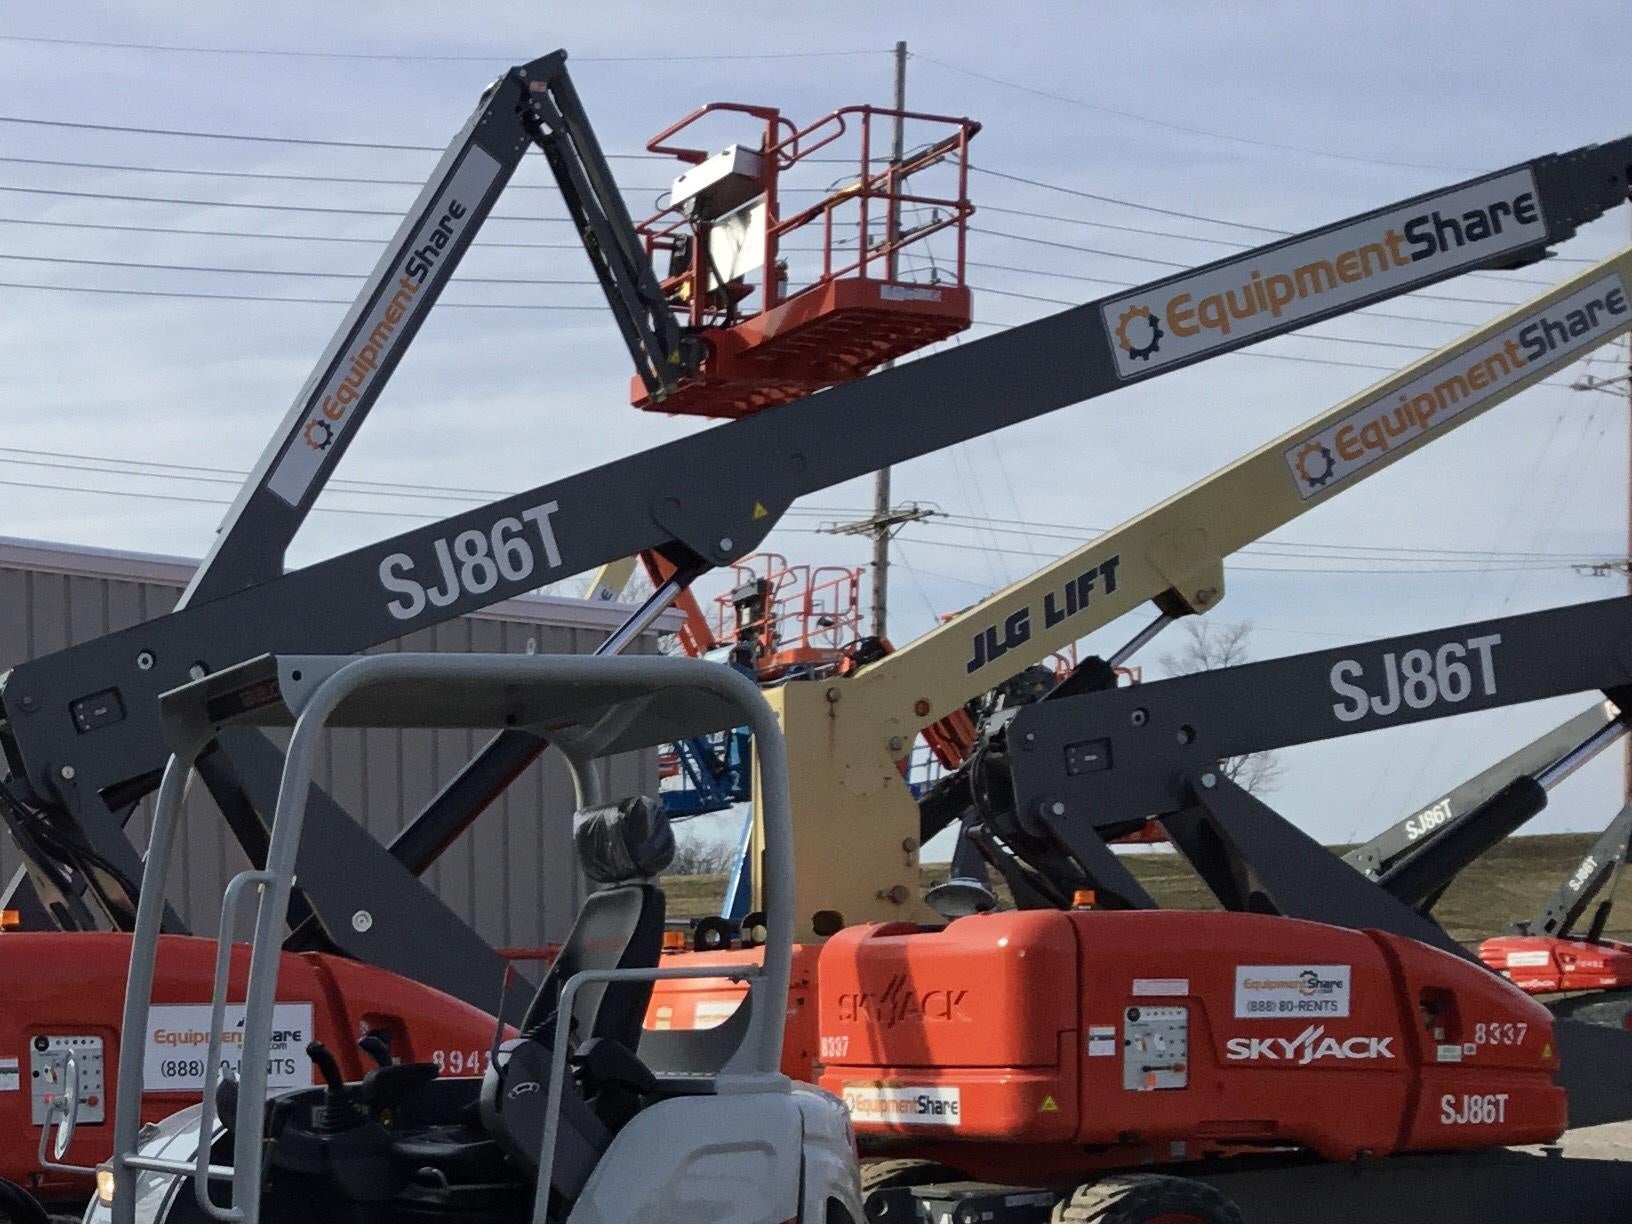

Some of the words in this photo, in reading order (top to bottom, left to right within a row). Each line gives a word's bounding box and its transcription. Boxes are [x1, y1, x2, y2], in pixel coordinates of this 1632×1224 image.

[1165, 191, 1538, 338] EquipmentShare
[321, 198, 468, 422] EquipmentShare
[1334, 287, 1628, 462] EquipmentShare
[378, 499, 563, 620] SJ86T
[966, 606, 1032, 674] JLG
[1043, 553, 1120, 629] LIFT
[1329, 633, 1502, 722] SJ86T
[1405, 798, 1453, 840] SJ86T
[1243, 978, 1343, 993] EquipmentShare
[1246, 1001, 1276, 1013] (888)
[1278, 1000, 1338, 1012] 80-RENTS
[1226, 1024, 1396, 1065] SKYJACK
[1474, 1022, 1528, 1045] 8337
[161, 1060, 204, 1078] (888)
[854, 1095, 959, 1115] EquipmentShare
[1440, 1093, 1509, 1124] SJ86T
